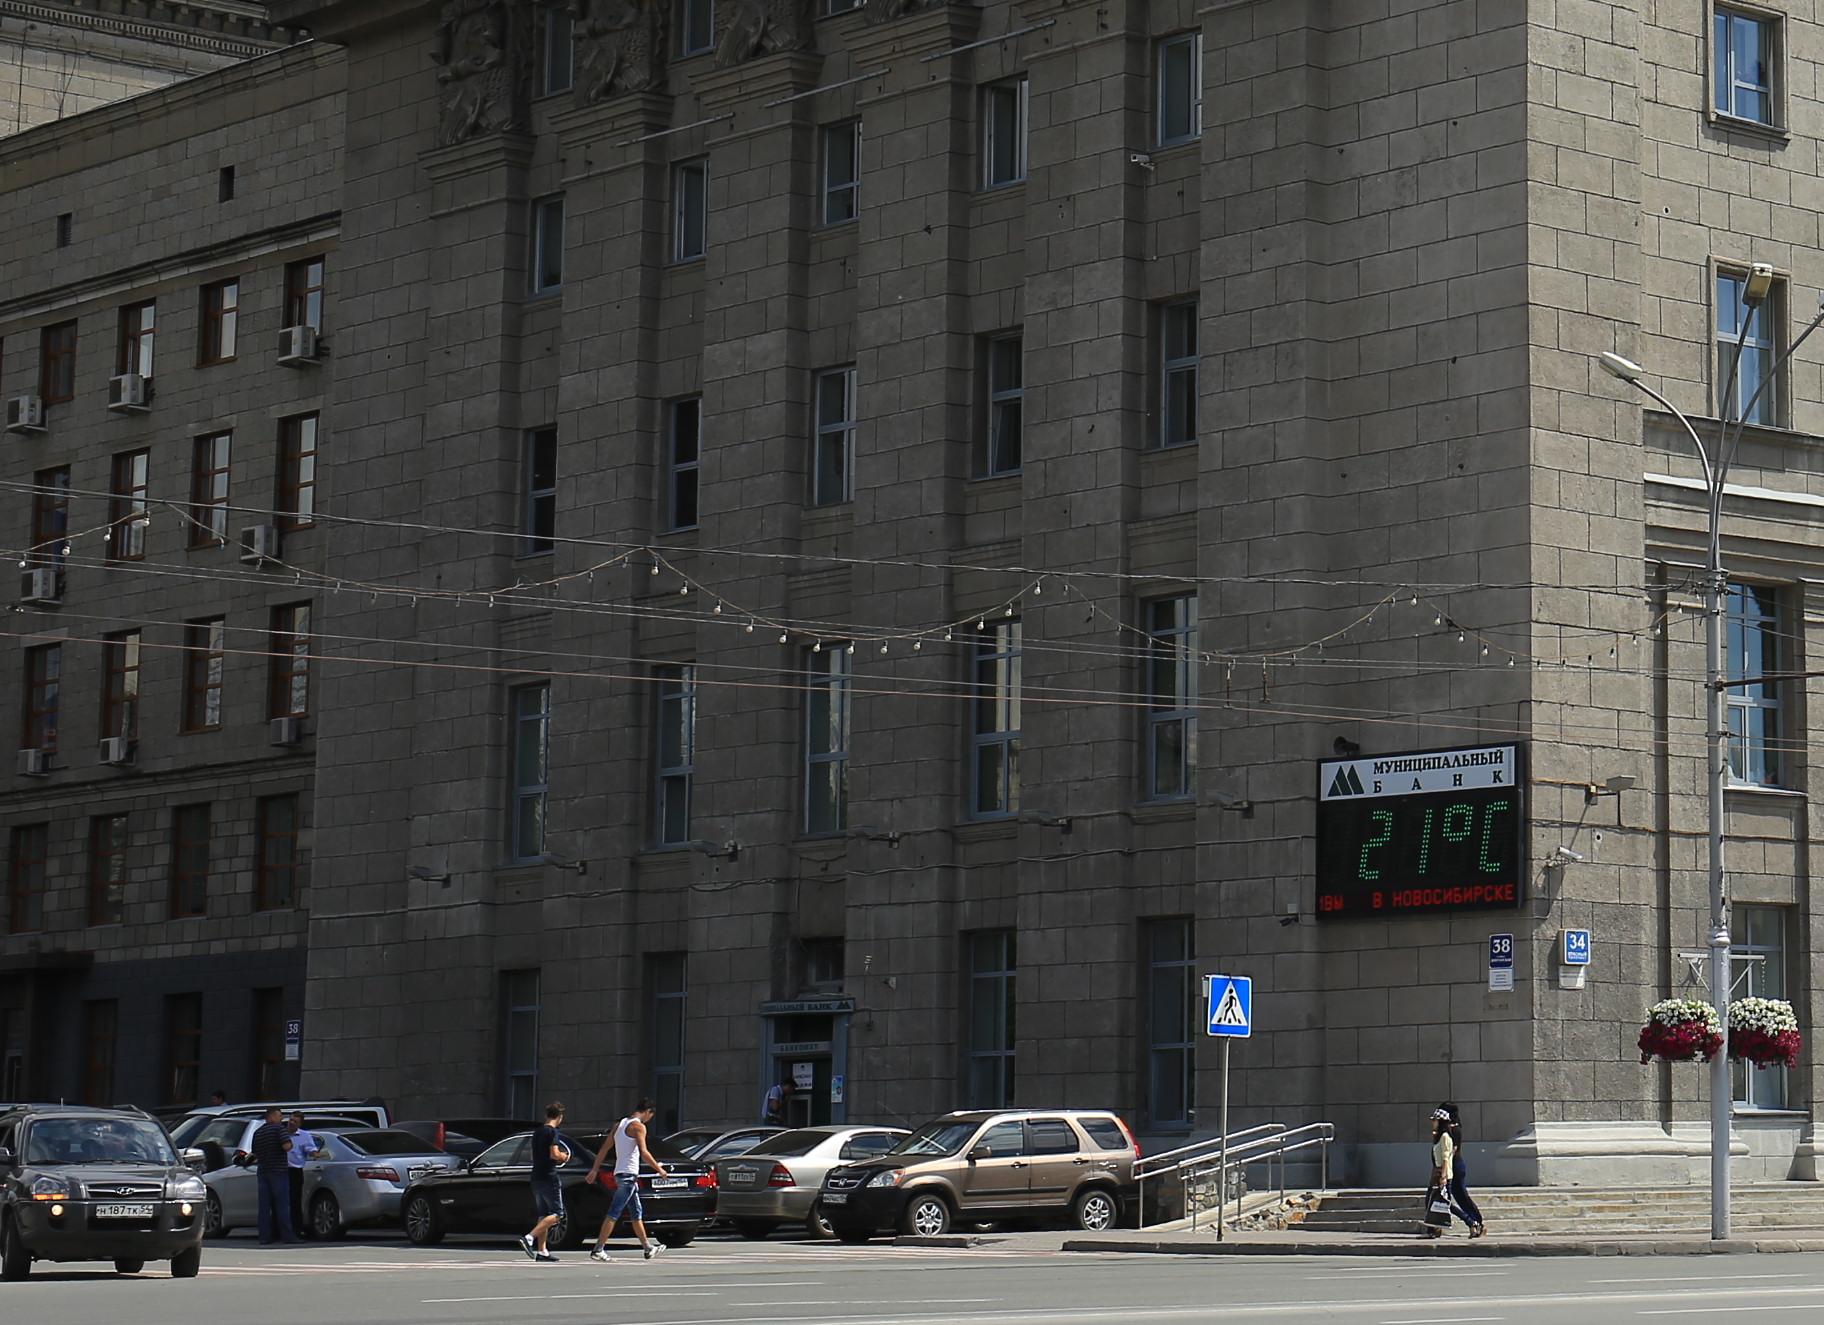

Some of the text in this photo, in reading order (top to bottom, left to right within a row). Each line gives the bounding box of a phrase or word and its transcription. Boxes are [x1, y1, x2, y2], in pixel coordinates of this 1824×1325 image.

[1373, 749, 1504, 775] МУНИЦИПАЛЬНЫЙ
[1372, 891, 1383, 909] В
[1392, 883, 1515, 908] НОВОСИБИРСКЕ
[1492, 938, 1511, 954] 38
[1569, 934, 1586, 950] 34
[287, 1023, 299, 1034] 38
